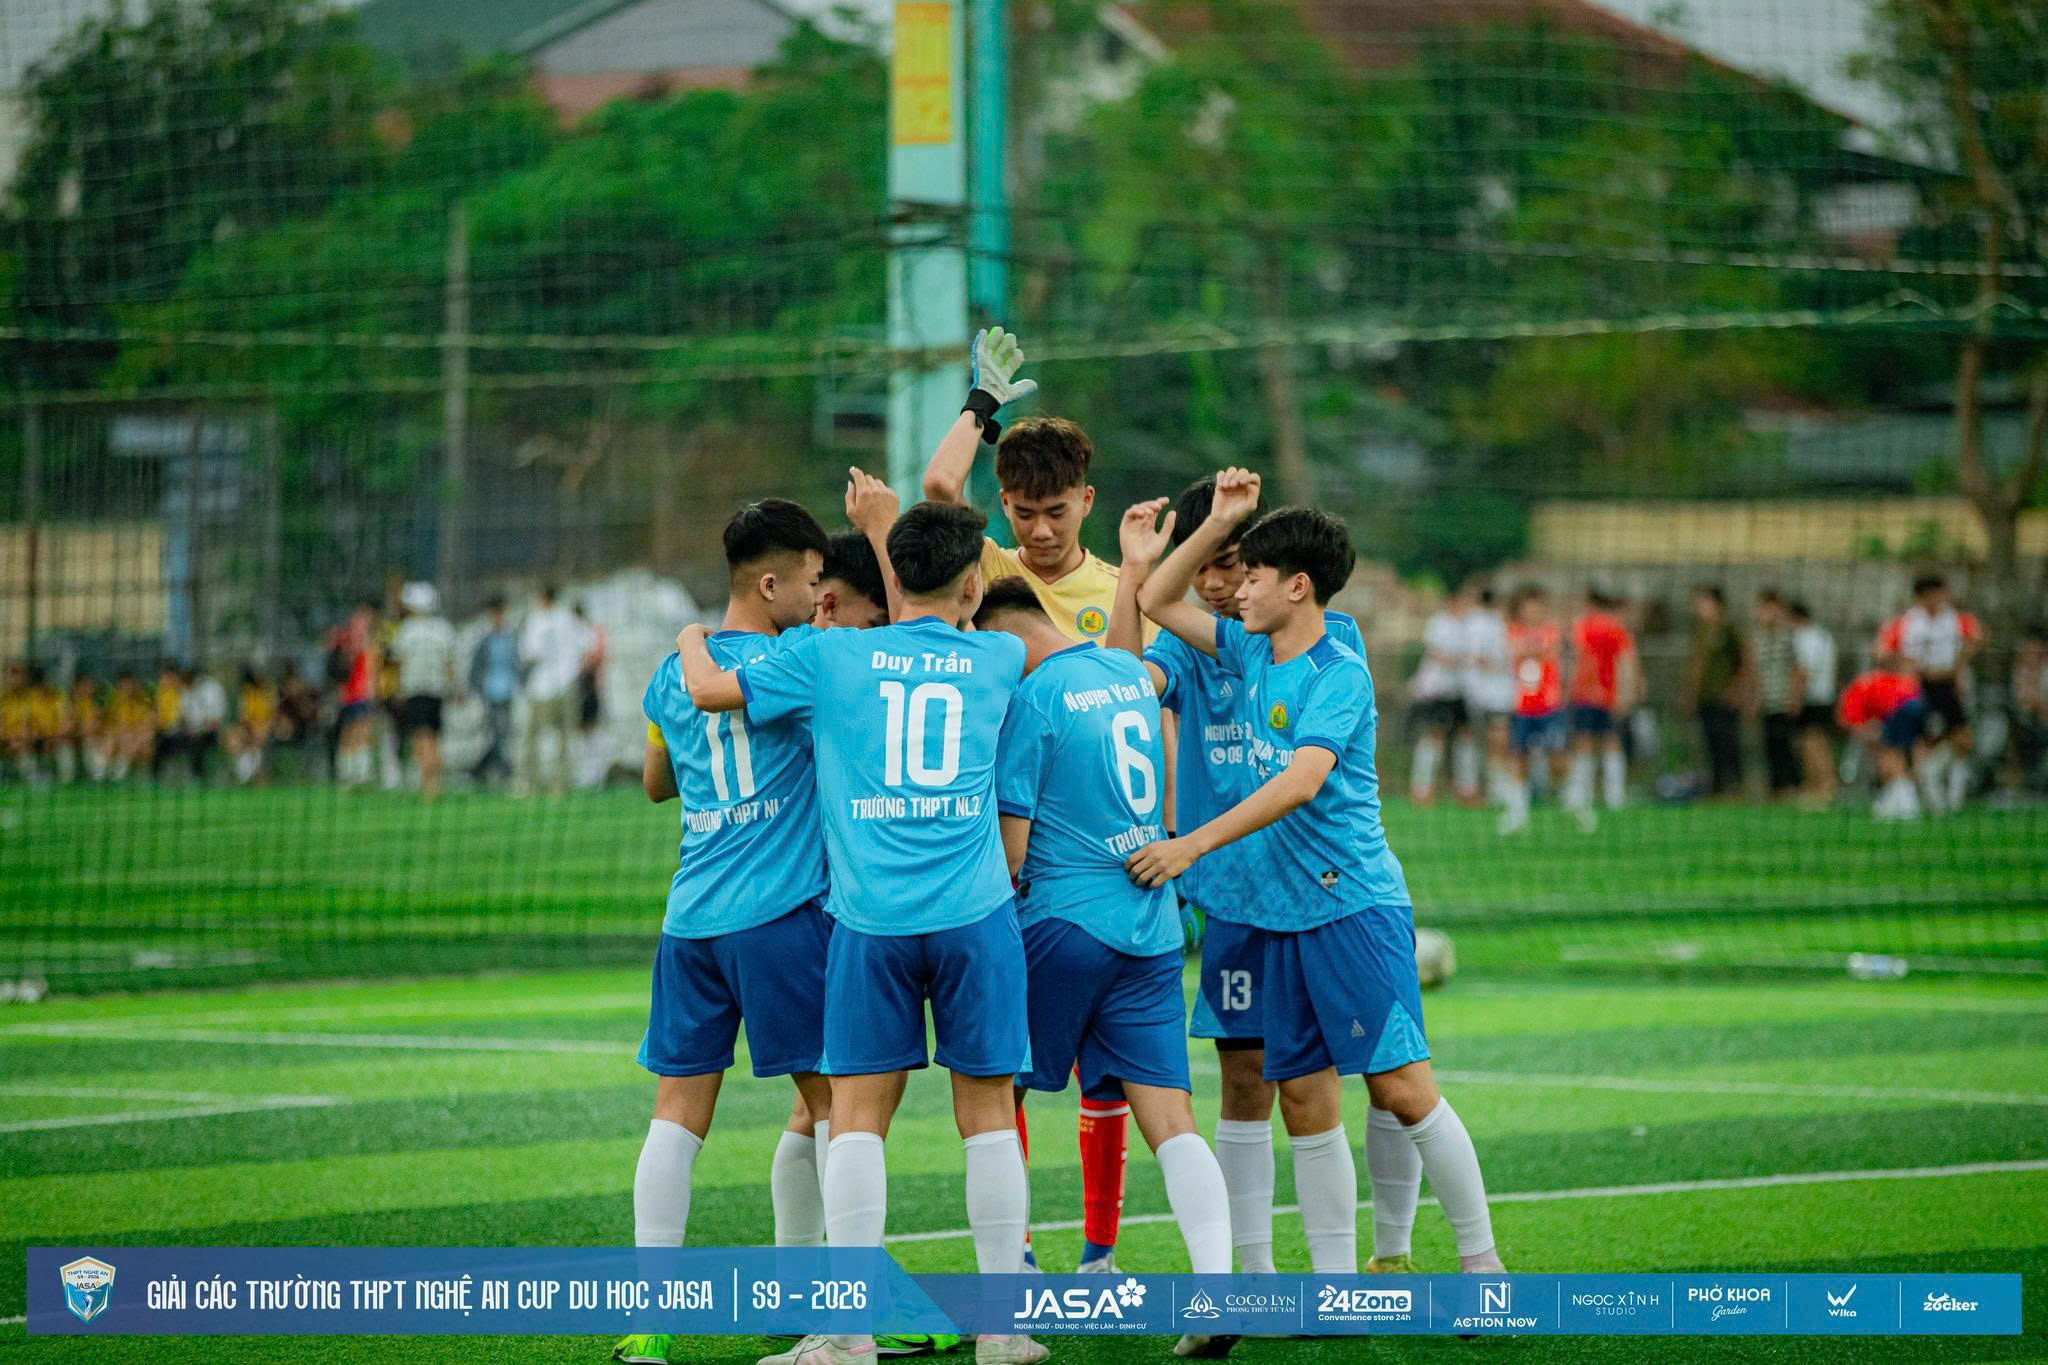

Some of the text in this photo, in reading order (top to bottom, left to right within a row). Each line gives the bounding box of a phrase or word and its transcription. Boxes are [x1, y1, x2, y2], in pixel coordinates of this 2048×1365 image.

[871, 650, 972, 675] Duy Trần
[703, 707, 755, 801] 11
[879, 681, 963, 787] 10
[1112, 710, 1157, 815] 6
[724, 802, 760, 825] THPT
[851, 794, 981, 819] TRƯỜNG THPT NL2
[1220, 969, 1252, 1011] 13
